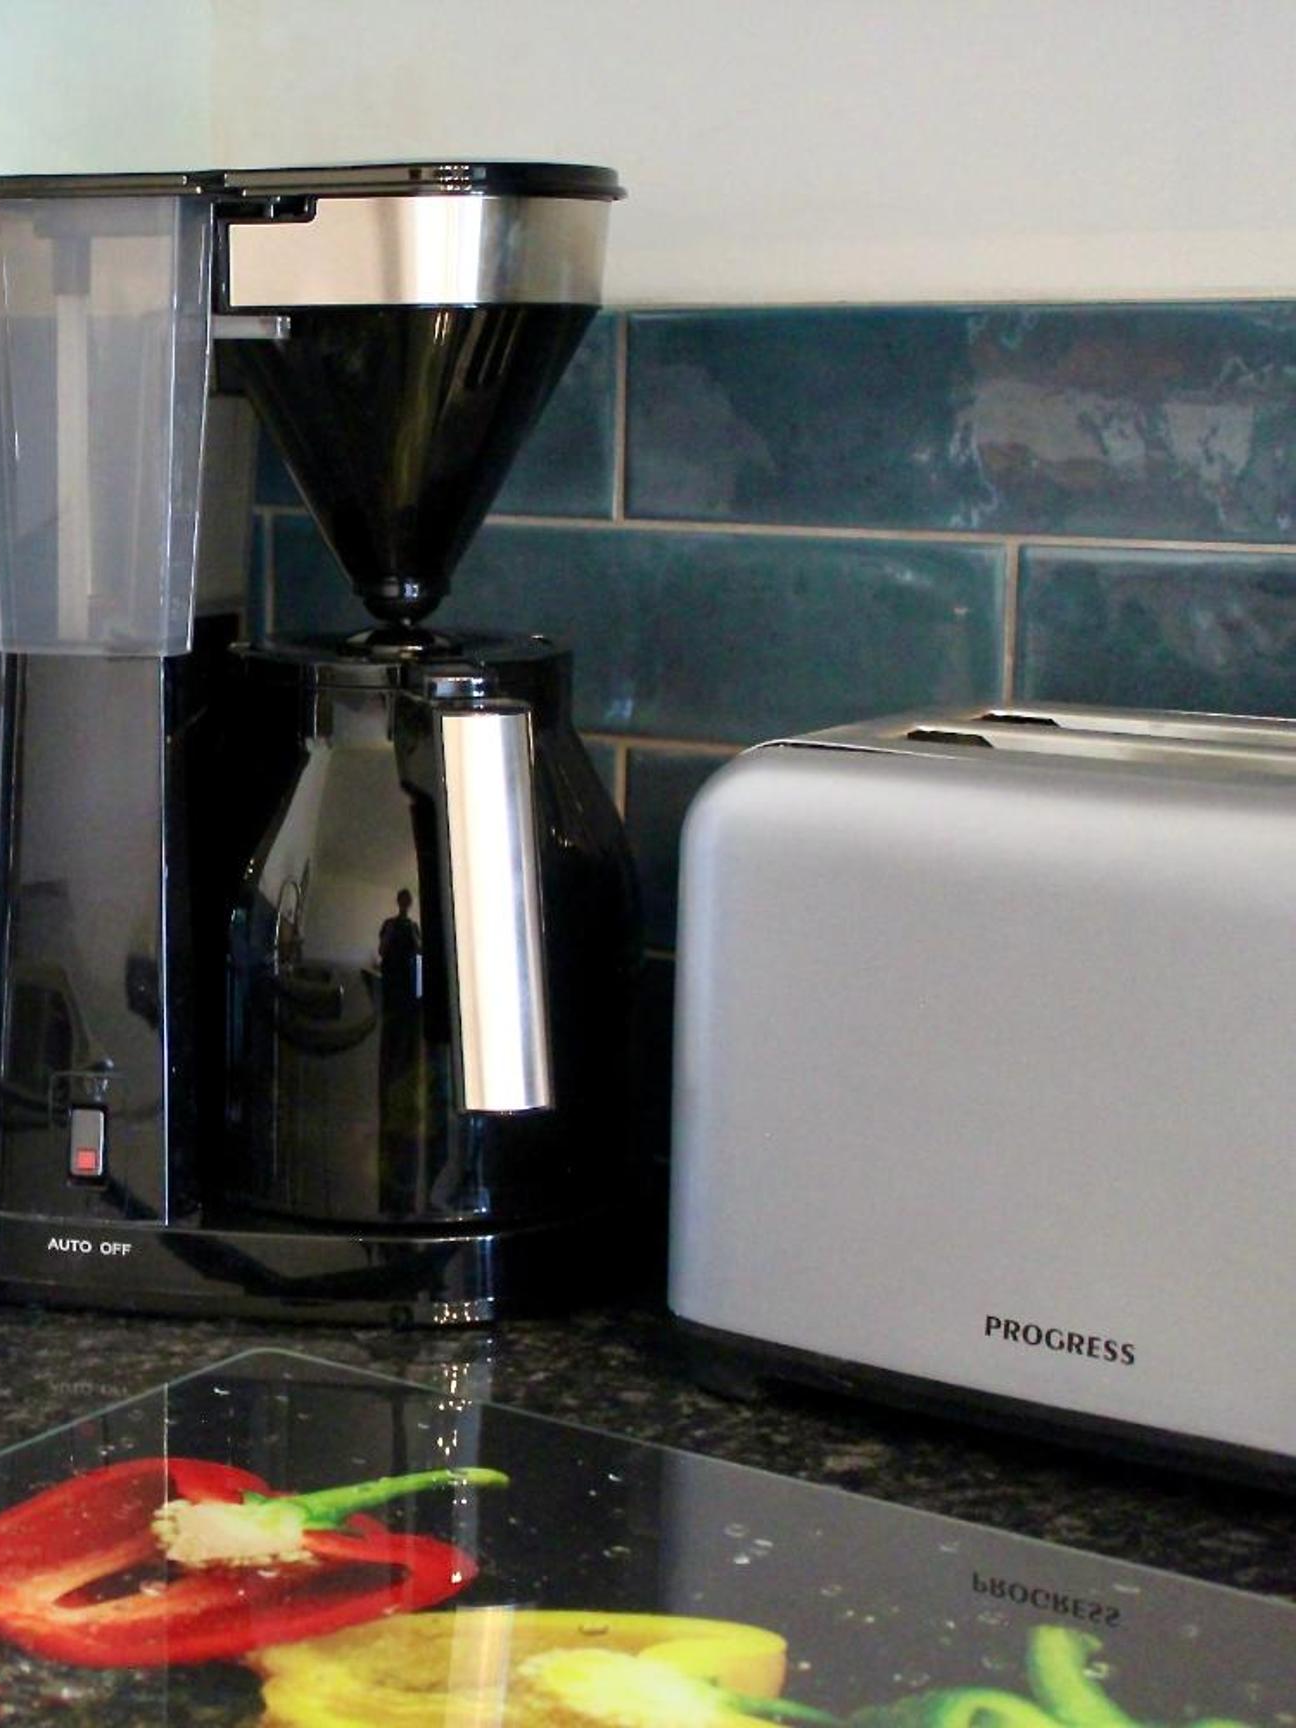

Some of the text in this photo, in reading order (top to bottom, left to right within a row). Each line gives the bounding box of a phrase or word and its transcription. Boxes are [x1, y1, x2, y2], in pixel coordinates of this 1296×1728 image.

[47, 1237, 132, 1256] AUTO OFF
[984, 1314, 1137, 1367] PROGRESS
